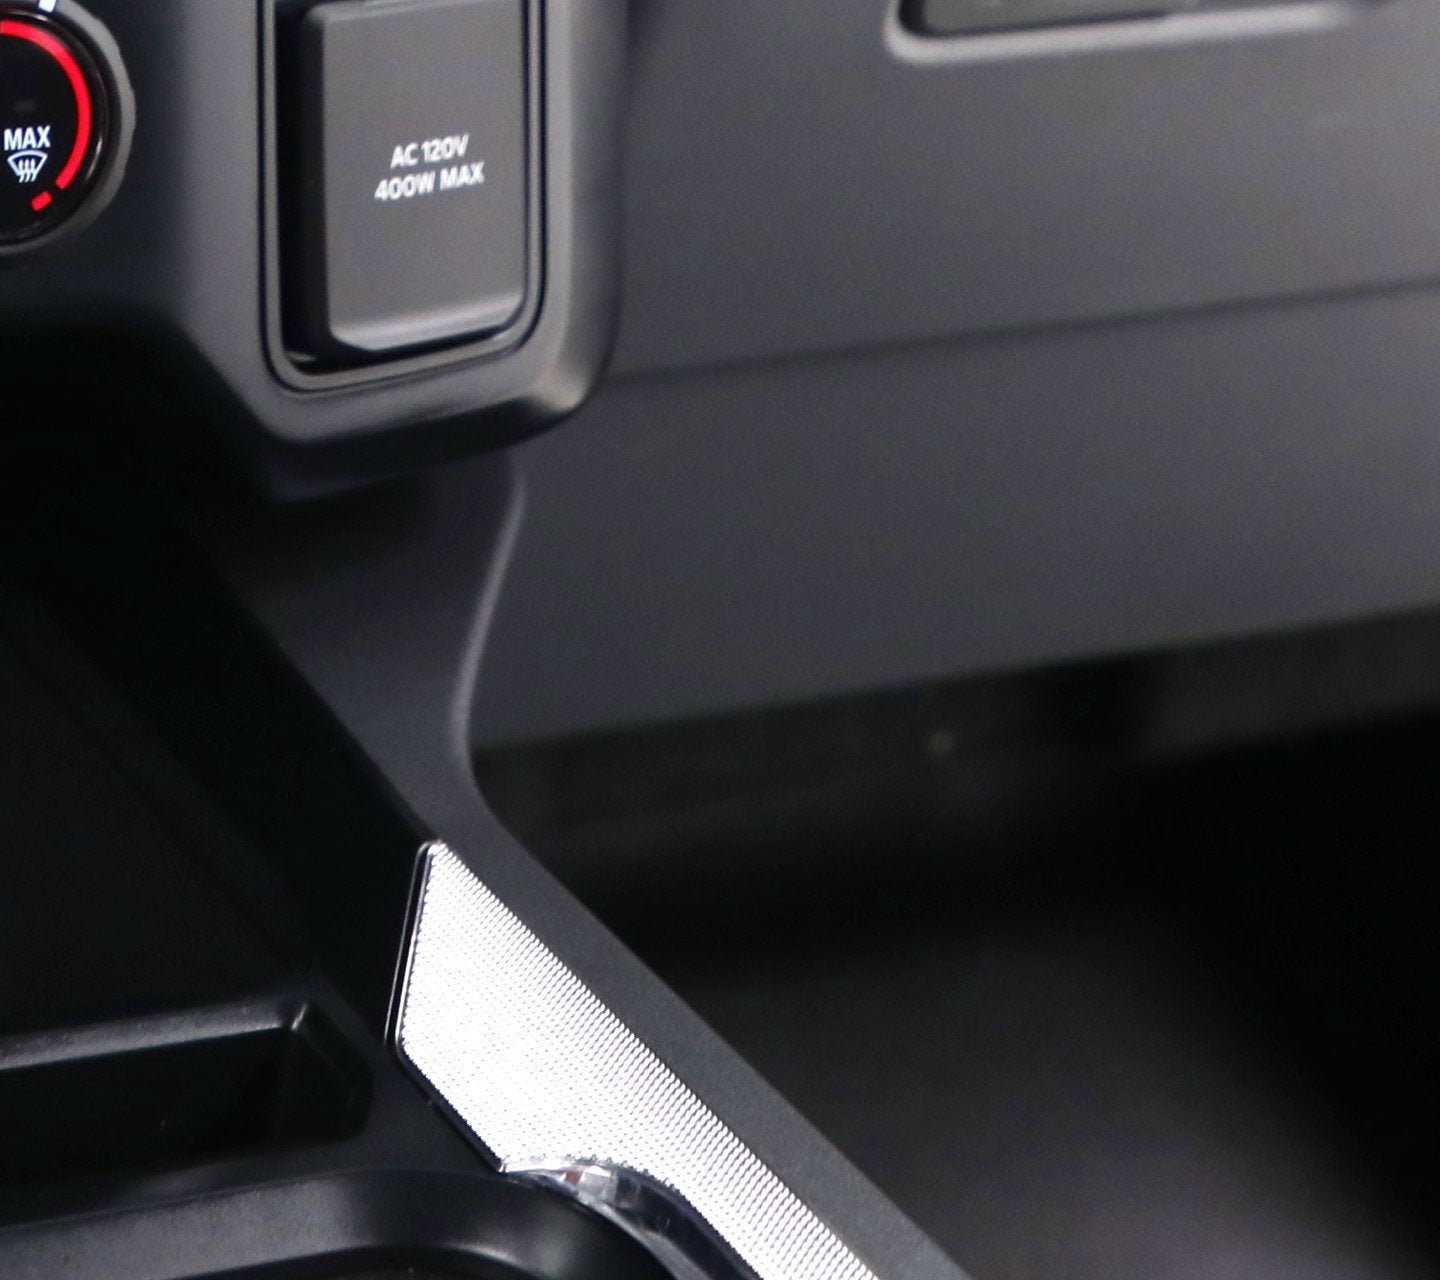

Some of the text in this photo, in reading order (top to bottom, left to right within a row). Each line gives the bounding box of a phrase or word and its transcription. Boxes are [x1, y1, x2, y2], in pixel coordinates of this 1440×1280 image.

[3, 125, 51, 150] MAX
[390, 134, 469, 168] AC 120V
[374, 161, 484, 201] 400W MAX
